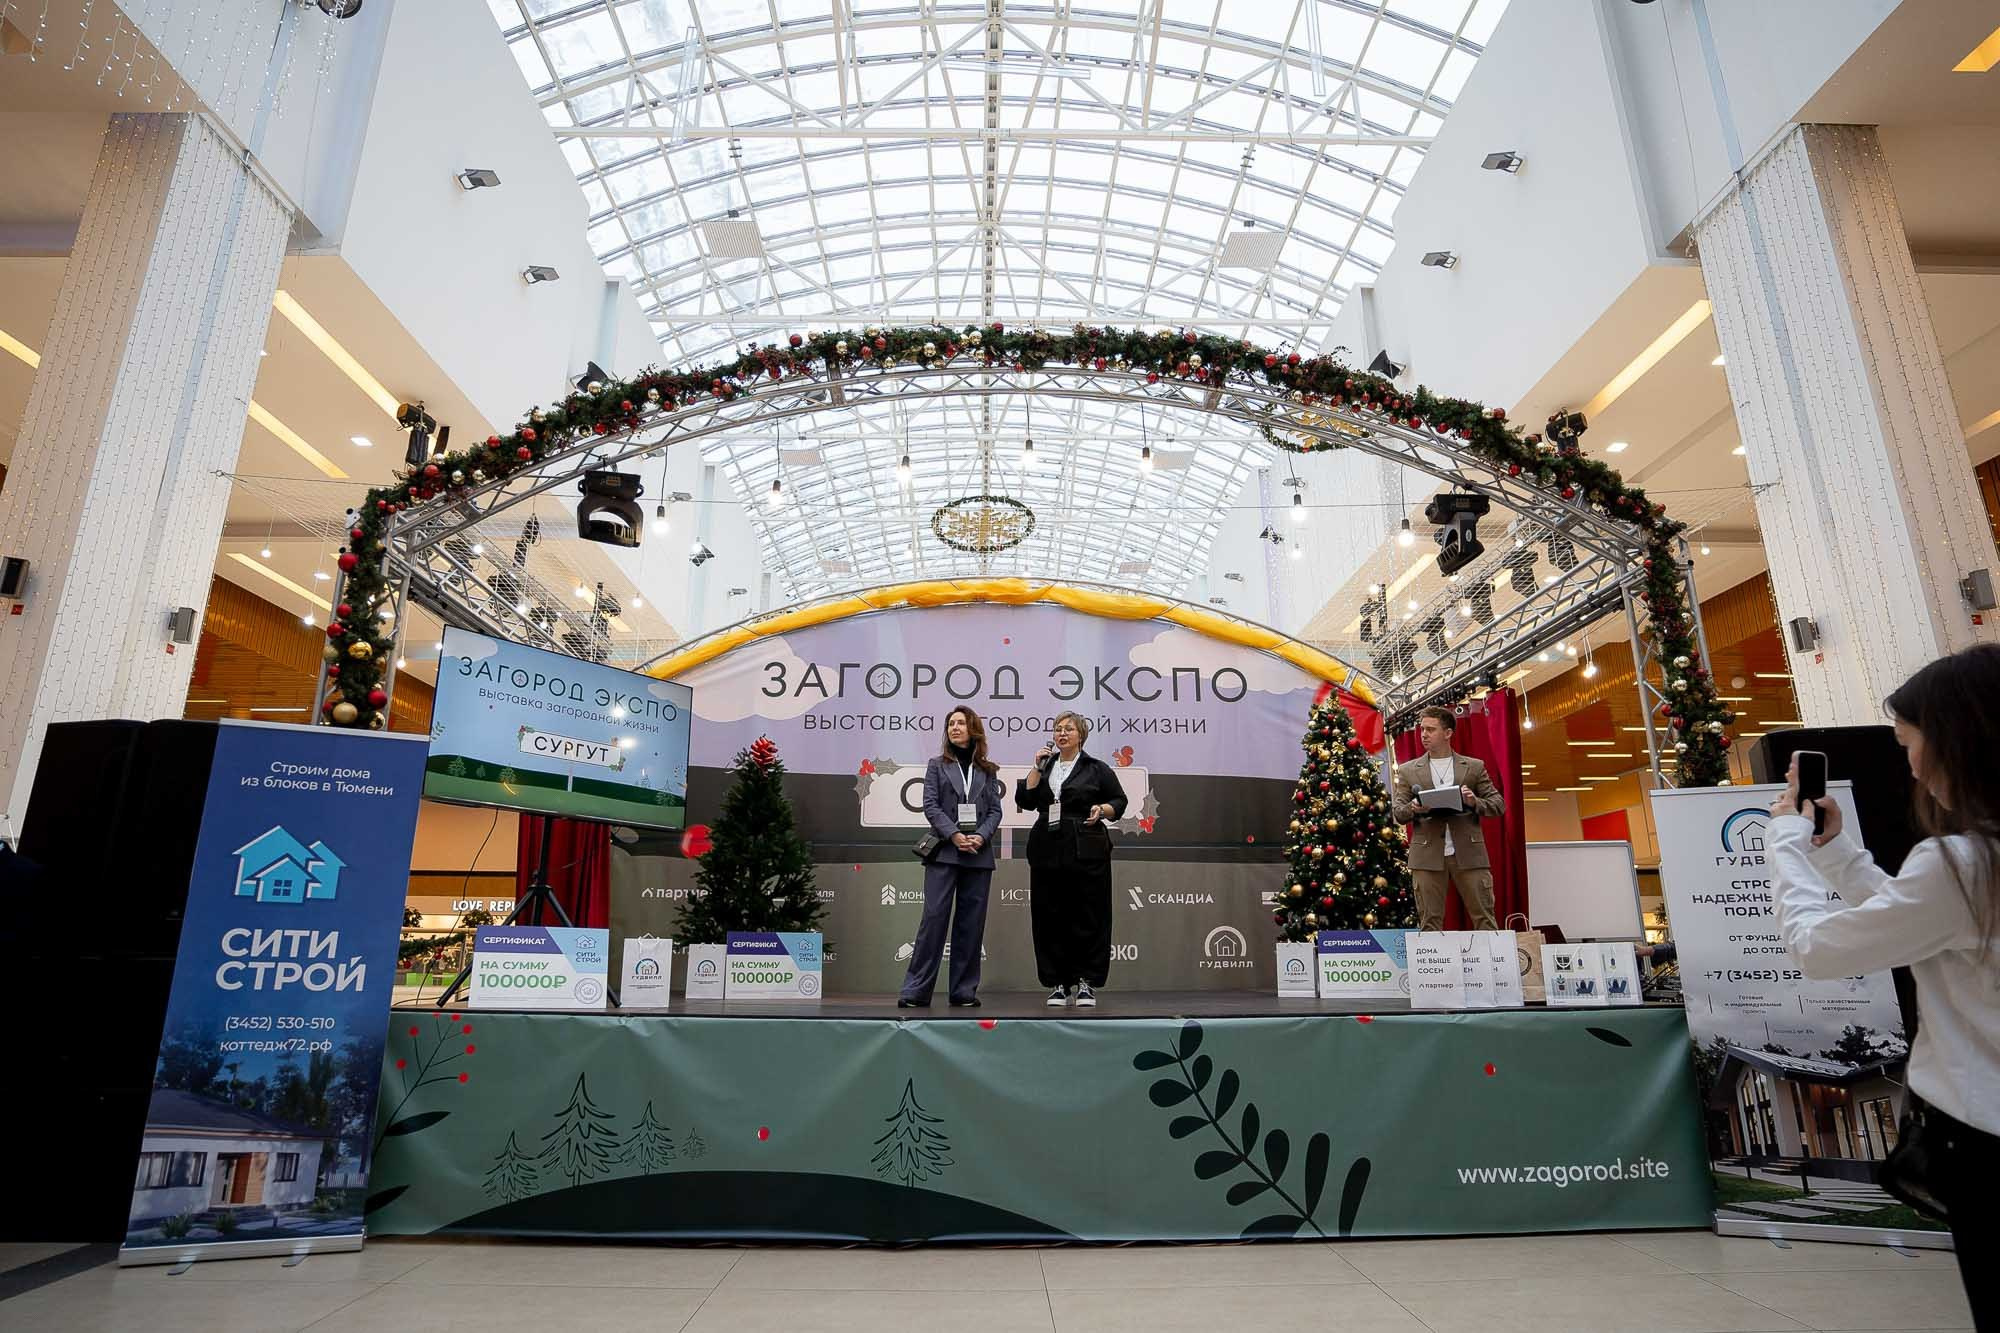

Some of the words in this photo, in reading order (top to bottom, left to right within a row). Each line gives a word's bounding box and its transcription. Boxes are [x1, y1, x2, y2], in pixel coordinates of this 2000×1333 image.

[458, 656, 584, 702] ЗАГОРОД
[595, 688, 678, 722] ЭКСПО
[761, 662, 1024, 700] ЗАГОРОД
[1048, 665, 1248, 703] ЭКСПО
[478, 688, 543, 709] выставка
[623, 719, 659, 734] жизни
[803, 712, 934, 732] выставка
[1120, 715, 1207, 735] жизни
[534, 736, 609, 762] СУРГУТ
[270, 761, 329, 777] Строим
[332, 767, 371, 780] дома
[240, 776, 259, 787] из
[263, 776, 318, 791] блоков
[322, 782, 331, 791] в
[335, 781, 394, 796] Тюмени
[452, 900, 483, 912] LOVE
[1148, 893, 1215, 904] СКАНДИА
[1724, 906, 1761, 918] ПОД
[221, 928, 340, 959] СИТИ
[483, 936, 547, 945] СЕРТИФИКАТ
[1743, 947, 1759, 955] ДО
[480, 960, 499, 970] НА
[502, 961, 549, 970] СУММУ
[731, 961, 745, 969] НА
[747, 961, 780, 969] СУММУ
[1199, 960, 1254, 968] ГУДВИЛЛ
[1340, 960, 1376, 968] СУММУ
[215, 956, 367, 992] СТРОЙ
[1704, 970, 1722, 980] +7
[1727, 969, 1779, 982] (3452)
[225, 1016, 272, 1032] (3452)
[276, 1016, 335, 1030] 530-510
[219, 1038, 333, 1054] коттедж72.рф
[1457, 1156, 1670, 1188] www.zagorod.site
